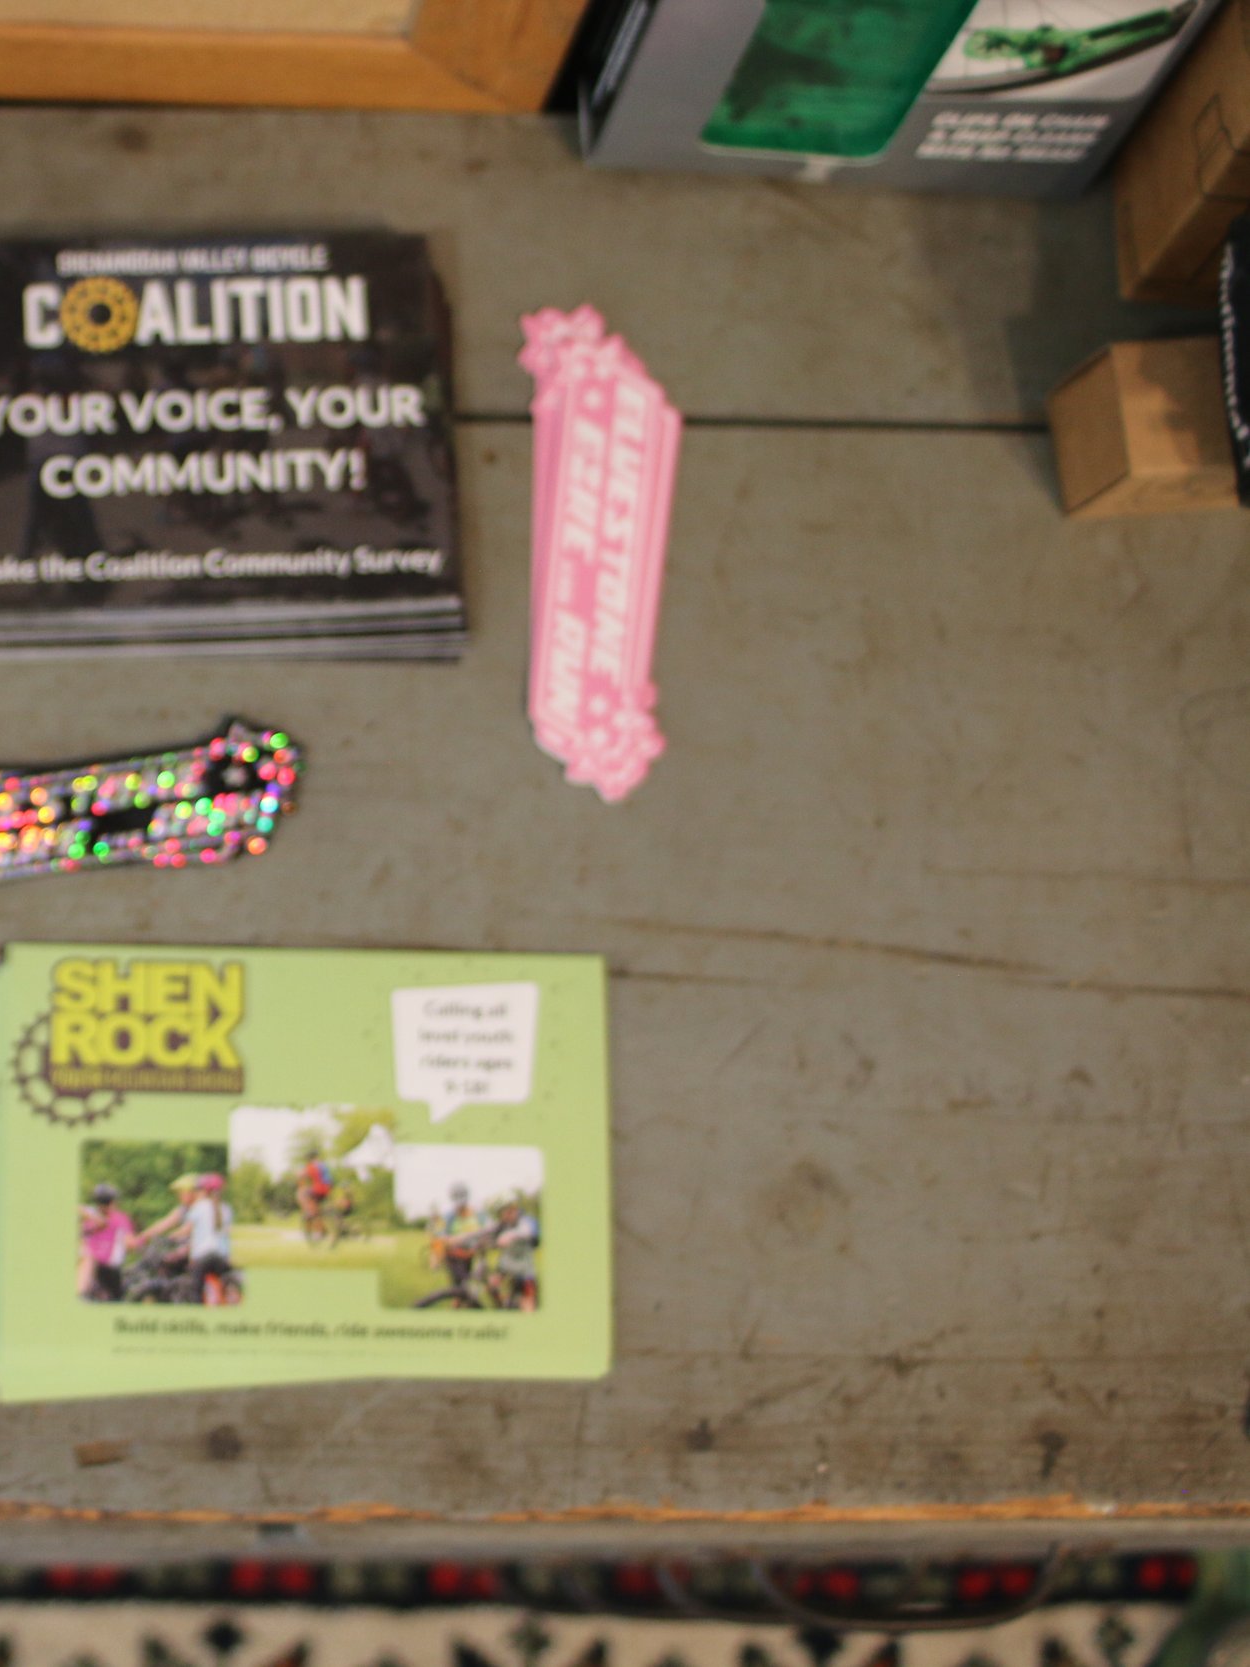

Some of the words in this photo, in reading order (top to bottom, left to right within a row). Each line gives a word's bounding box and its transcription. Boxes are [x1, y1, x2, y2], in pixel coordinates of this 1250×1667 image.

[22, 276, 369, 352] COALITION
[120, 388, 282, 432] VOICE,
[285, 384, 425, 428] YOUR
[40, 450, 367, 498] COMMUNITY!
[40, 554, 82, 582] the
[85, 551, 201, 580] Coalition
[203, 548, 350, 579] Community
[353, 545, 443, 576] Survey
[52, 959, 244, 1014] SHEN
[51, 1013, 243, 1069] ROCK
[113, 1317, 157, 1335] Build
